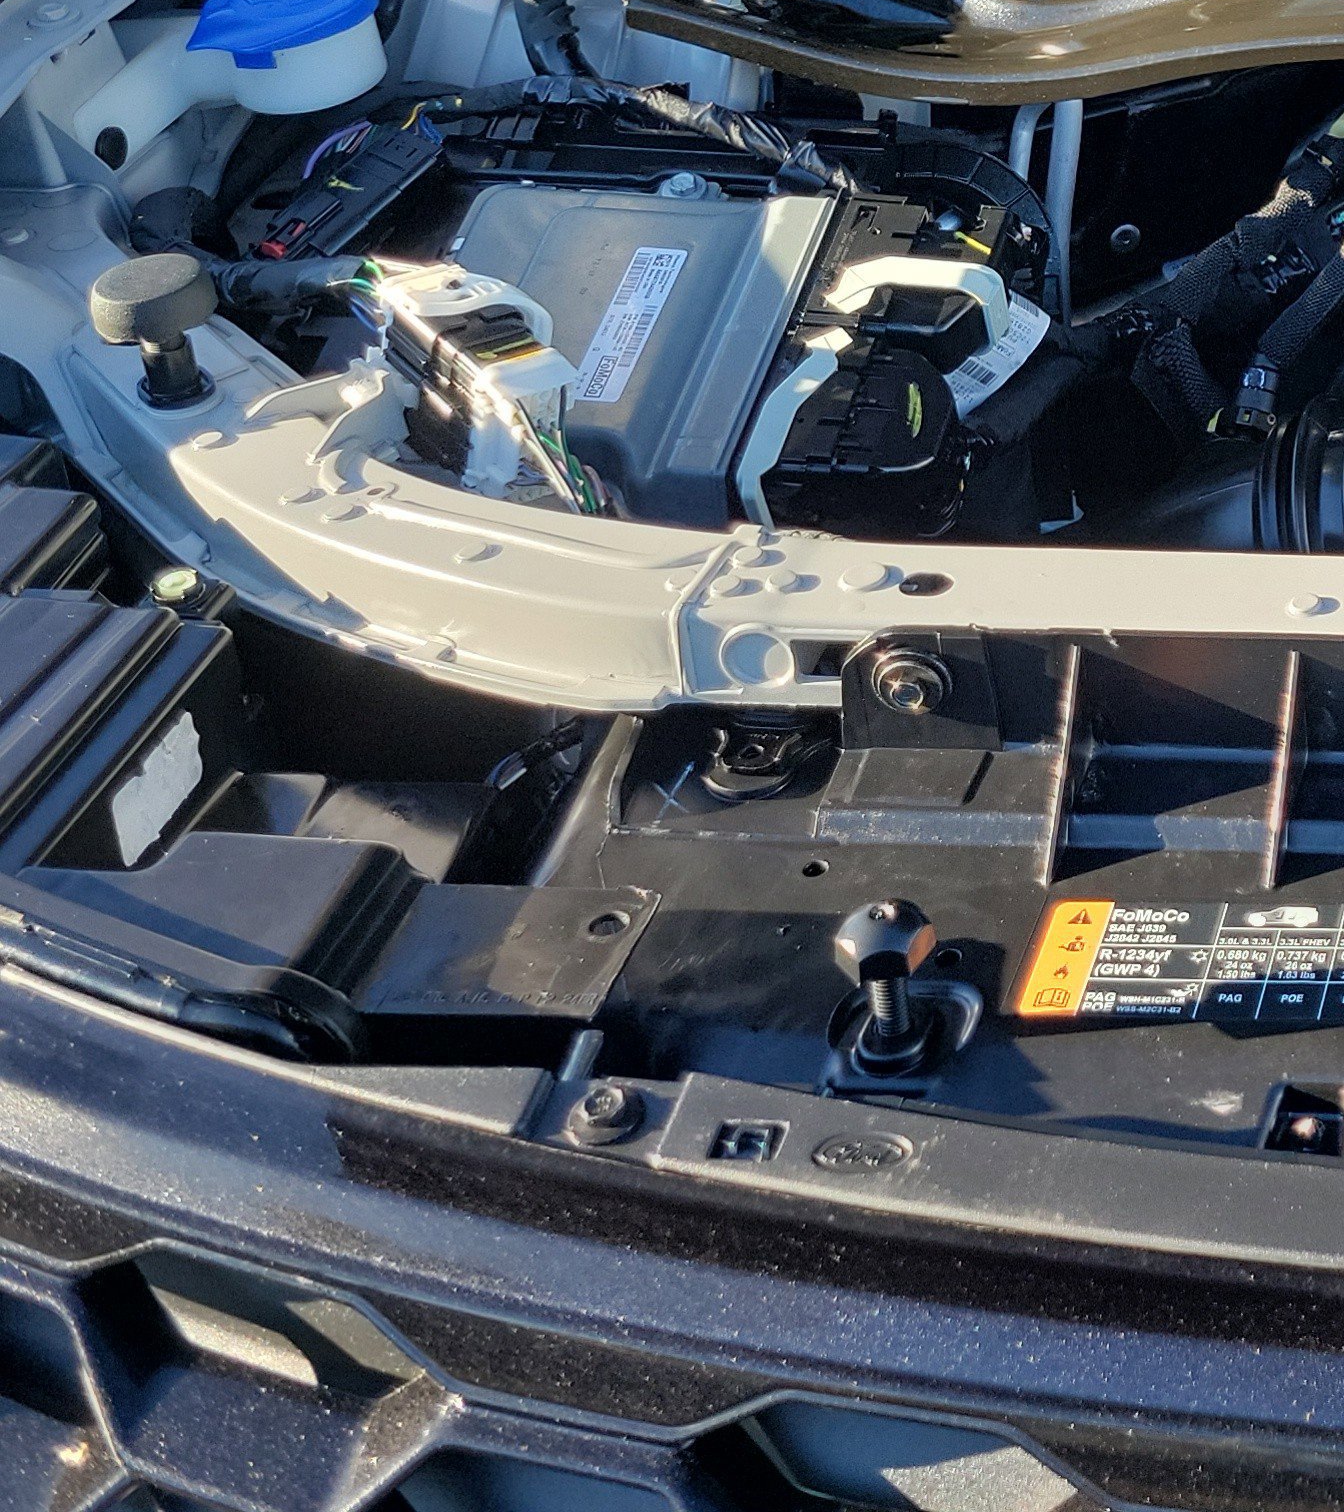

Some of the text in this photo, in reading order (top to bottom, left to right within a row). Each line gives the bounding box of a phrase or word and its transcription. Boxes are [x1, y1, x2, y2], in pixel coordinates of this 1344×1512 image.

[587, 358, 615, 396] FoMoCo
[1112, 909, 1190, 923] FoMoCo
[1109, 924, 1135, 932] SAE
[1301, 938, 1332, 946] FHEV
[1099, 949, 1172, 961] R-1234yf
[1216, 950, 1267, 962] 0.680 kg
[1277, 951, 1327, 963] 0.737 kg
[1094, 963, 1161, 978] (GWP 4)
[1217, 970, 1256, 978] 1.50 lbs
[1301, 971, 1316, 979] lbs
[1085, 991, 1117, 1001] PAG
[1218, 993, 1243, 1003] PAG
[1280, 994, 1304, 1003] POE
[1082, 1002, 1115, 1011] POE
